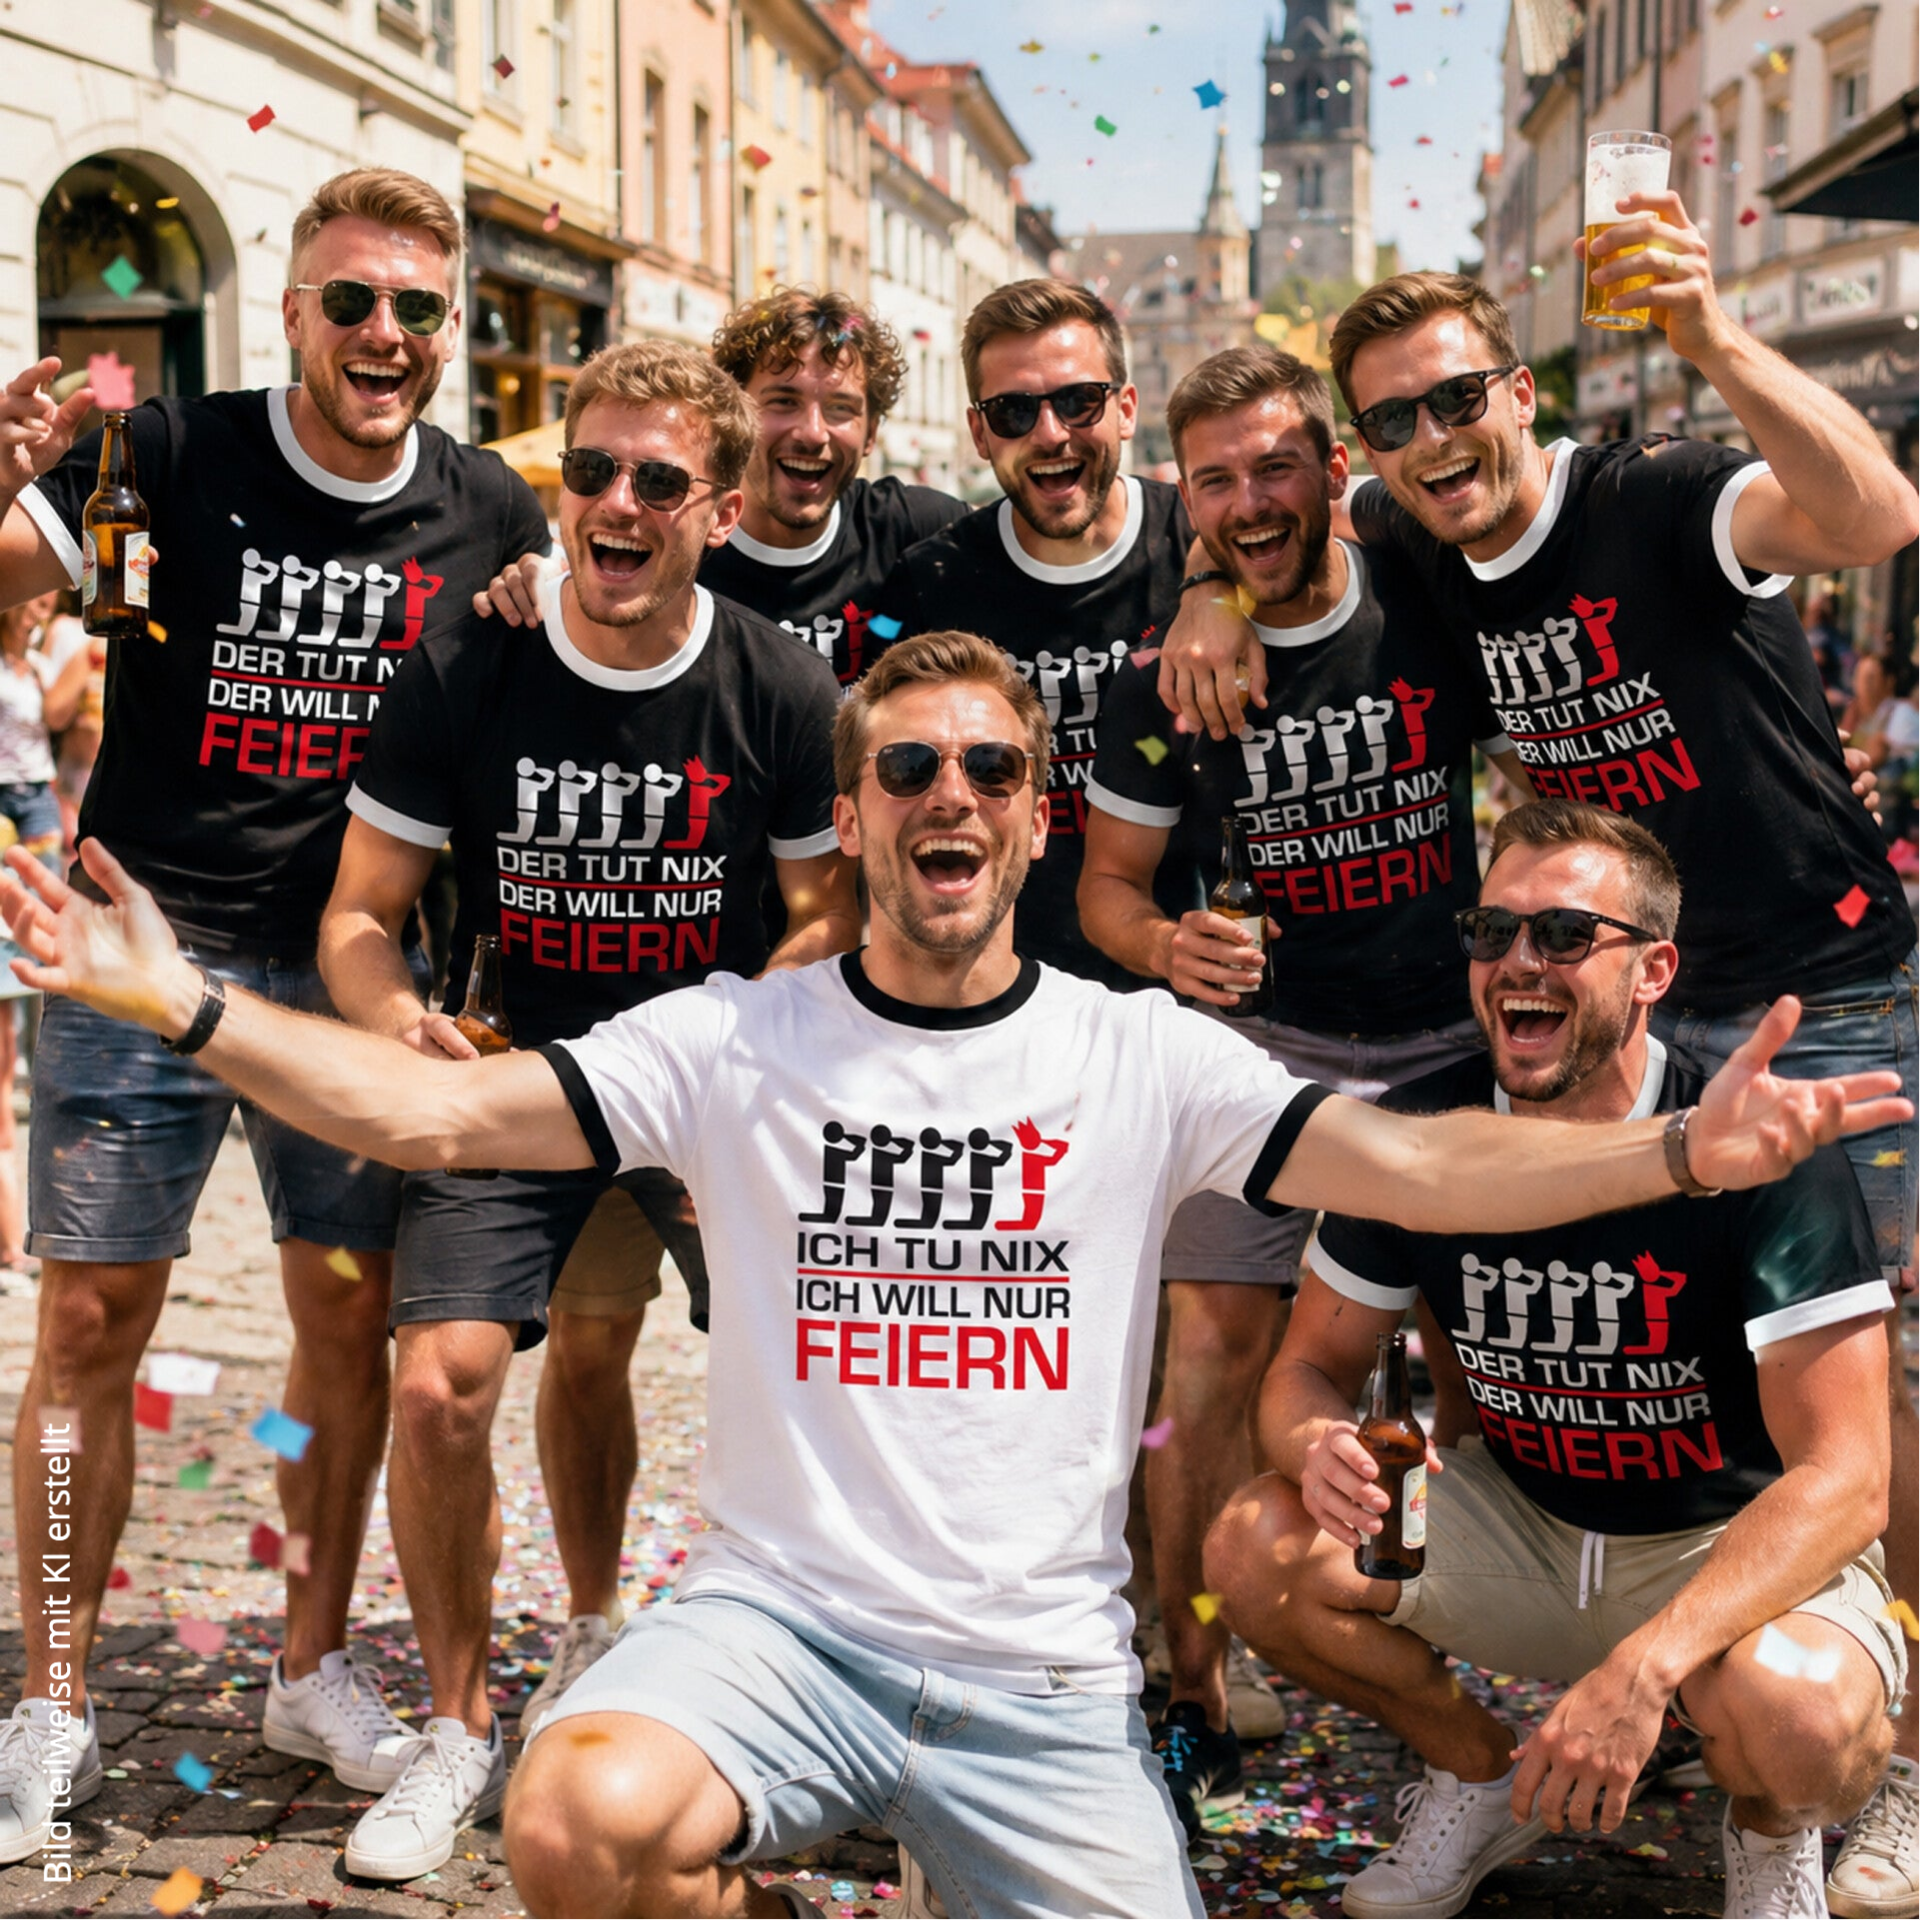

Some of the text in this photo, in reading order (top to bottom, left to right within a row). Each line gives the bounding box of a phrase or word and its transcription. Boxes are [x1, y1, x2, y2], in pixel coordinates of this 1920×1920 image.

[212, 640, 285, 676] DER
[296, 652, 367, 682] TUT
[207, 678, 271, 714] DER
[279, 687, 358, 721] WILL
[1495, 671, 1661, 732] DER TUT NIX
[1541, 734, 1603, 764] WILL
[1602, 708, 1676, 754] NUR
[1238, 766, 1448, 834] DER TUT NIX
[1525, 737, 1701, 812] EIERN
[1247, 802, 1449, 866] DER WILL NUR
[497, 846, 727, 882] DER TUT NIX
[1253, 832, 1453, 914] FEIERN
[499, 879, 722, 918] DER WILL NUR
[500, 908, 720, 973] FEIERN
[797, 1232, 1070, 1272] ICH TU NIX
[796, 1278, 1070, 1319] ICH WILL NUR
[796, 1317, 1070, 1391] FEIERN
[1455, 1342, 1705, 1389] DER TUT NIX
[1466, 1375, 1712, 1426] DER WILL NUR
[1477, 1403, 1724, 1480] FEIERN
